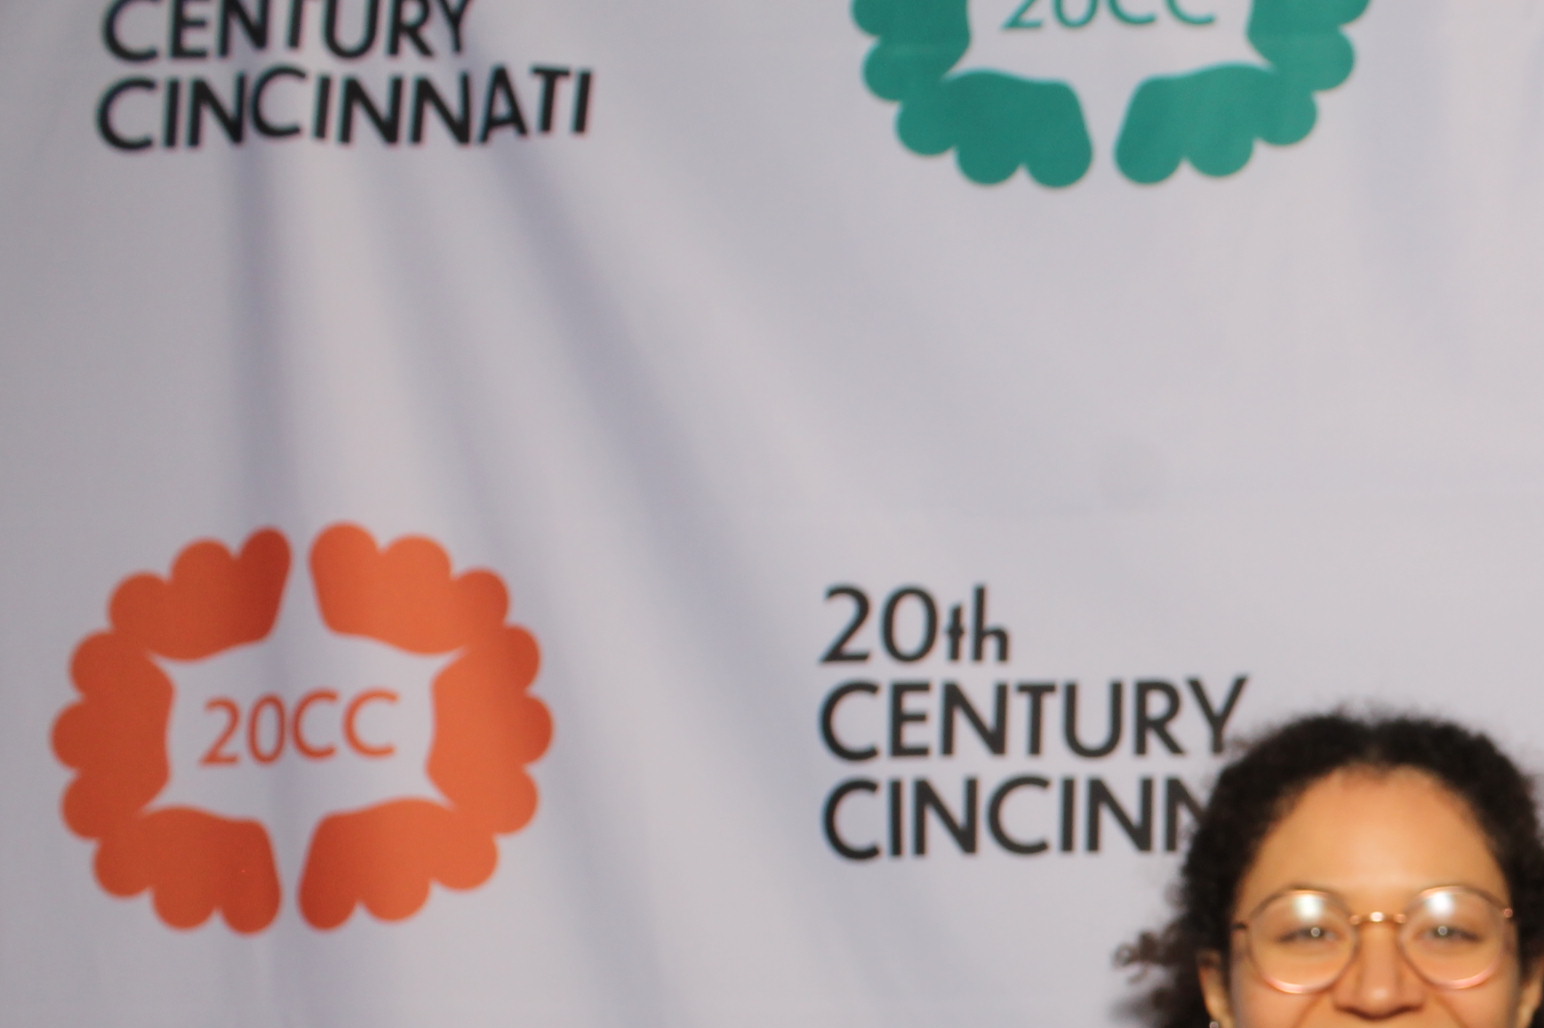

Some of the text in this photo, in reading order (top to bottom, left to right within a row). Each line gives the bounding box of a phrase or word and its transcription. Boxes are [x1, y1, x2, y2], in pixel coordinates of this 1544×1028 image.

[100, 0, 472, 62] CENTURY
[95, 64, 593, 153] CINCINNATI
[820, 584, 1010, 664] 20th
[202, 686, 401, 764] 20CC
[818, 674, 1249, 762] CENTURY
[821, 775, 1206, 861] CINCINN
